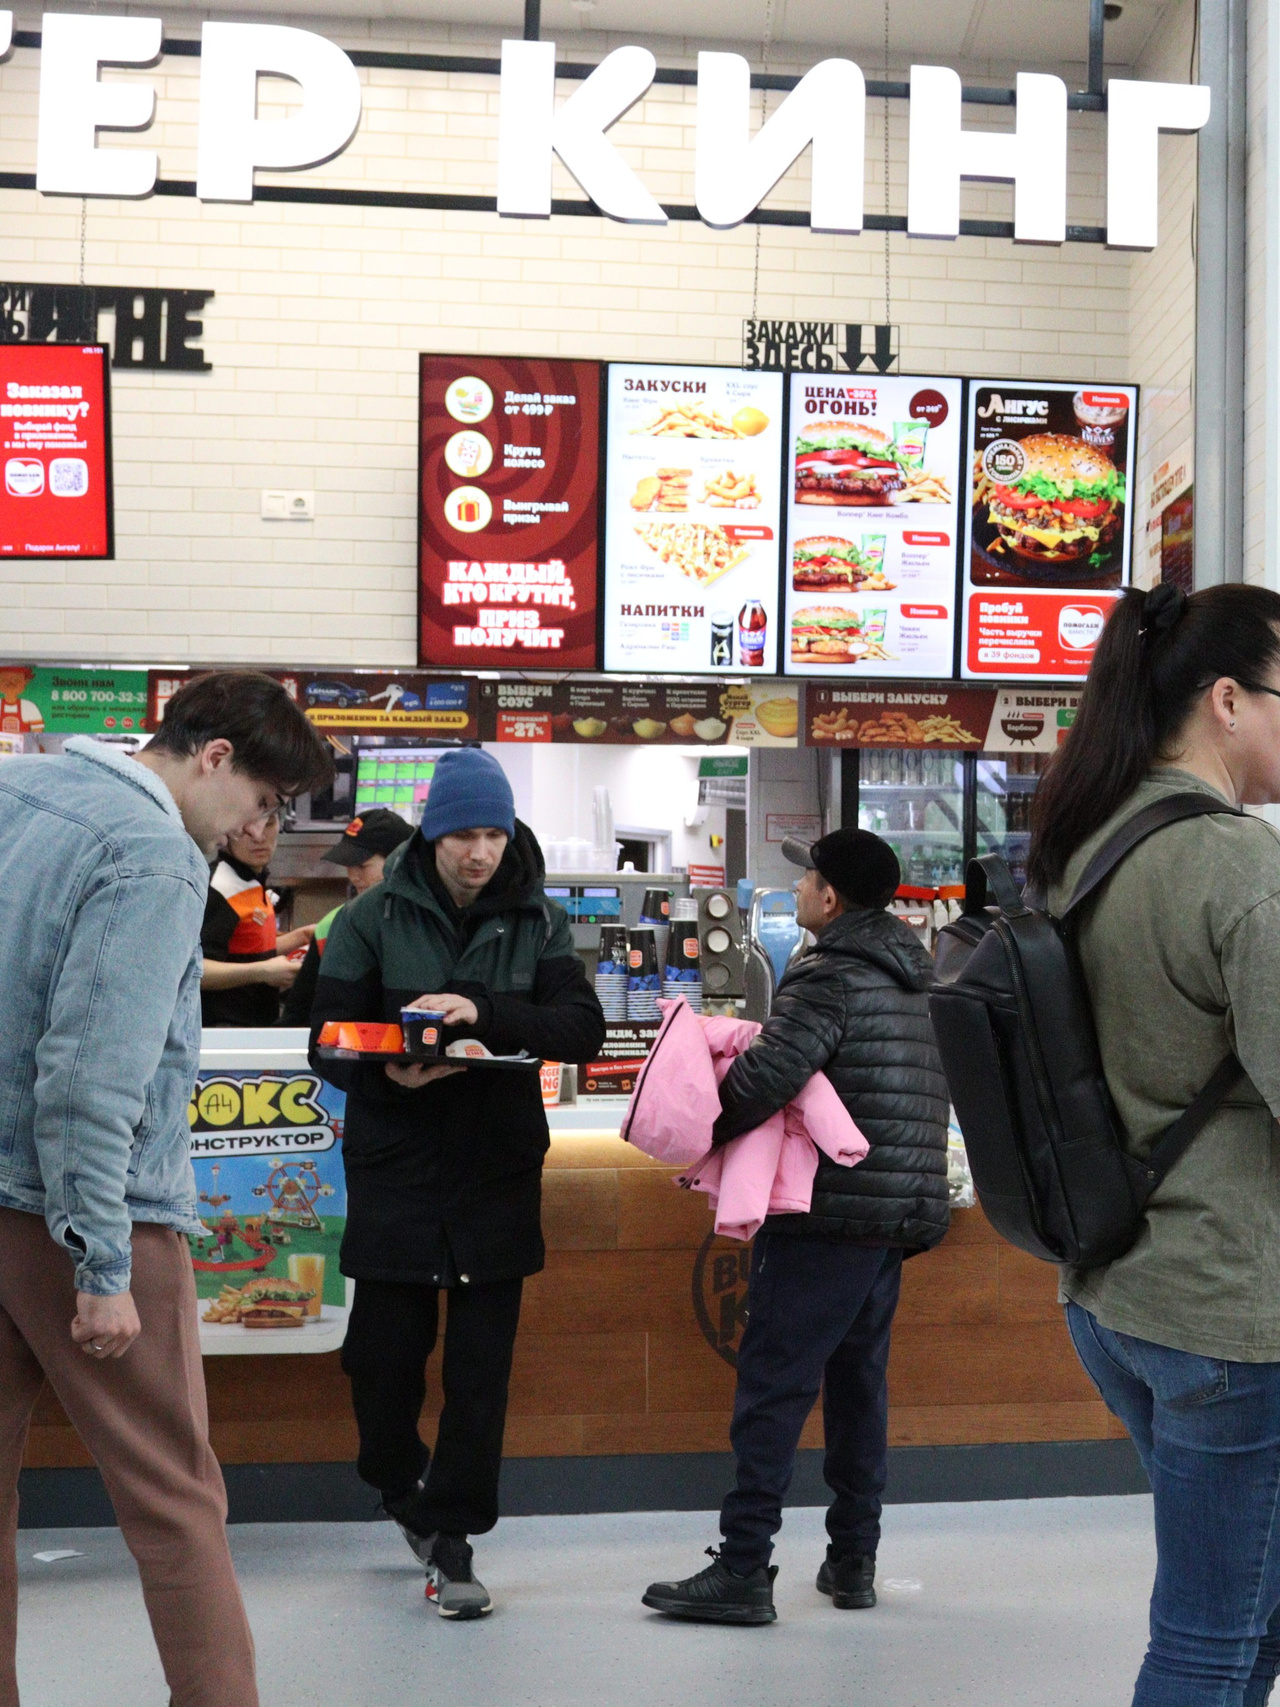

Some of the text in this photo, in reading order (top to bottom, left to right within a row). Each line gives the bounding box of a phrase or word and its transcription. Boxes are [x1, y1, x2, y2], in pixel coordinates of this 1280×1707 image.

[497, 38, 1211, 252] КИНГ
[746, 320, 835, 345] ЗАКАЖИ
[746, 343, 835, 372] ЗДЕСЬ
[6, 382, 83, 399] Заказал
[624, 378, 707, 394] ЗАКУСКИ
[805, 386, 846, 399] ЦЕНА
[504, 391, 576, 405] Делай заказ
[0, 402, 90, 421] новинку?
[504, 406, 519, 415] от
[804, 400, 878, 417] ОГОНЬ!
[504, 444, 541, 458] Крути
[504, 458, 545, 469] колесо
[503, 499, 570, 513] Выигрывай
[503, 514, 541, 525] призы
[448, 559, 572, 586] КАЖДЫЙ,
[443, 583, 577, 611] КТО КРУТИТ,
[620, 604, 706, 618] НАПИТКИ
[979, 602, 1024, 614] Пробуй
[478, 609, 540, 629] ПРИЗ
[979, 614, 1029, 624] новинки
[454, 627, 565, 648] ПОЛУЧИТ
[979, 627, 1043, 638] Часть выручки
[979, 637, 1035, 648] перечисляем
[1003, 651, 1035, 661] фондов
[52, 690, 59, 701] 8
[62, 690, 87, 702] 800
[498, 685, 553, 697] ВЫБЕРИ
[498, 697, 534, 708] СОУС
[832, 691, 949, 706] ВЫБЕРИ ЗАКУСКУ
[1016, 696, 1067, 708] ВЫБЕРИ
